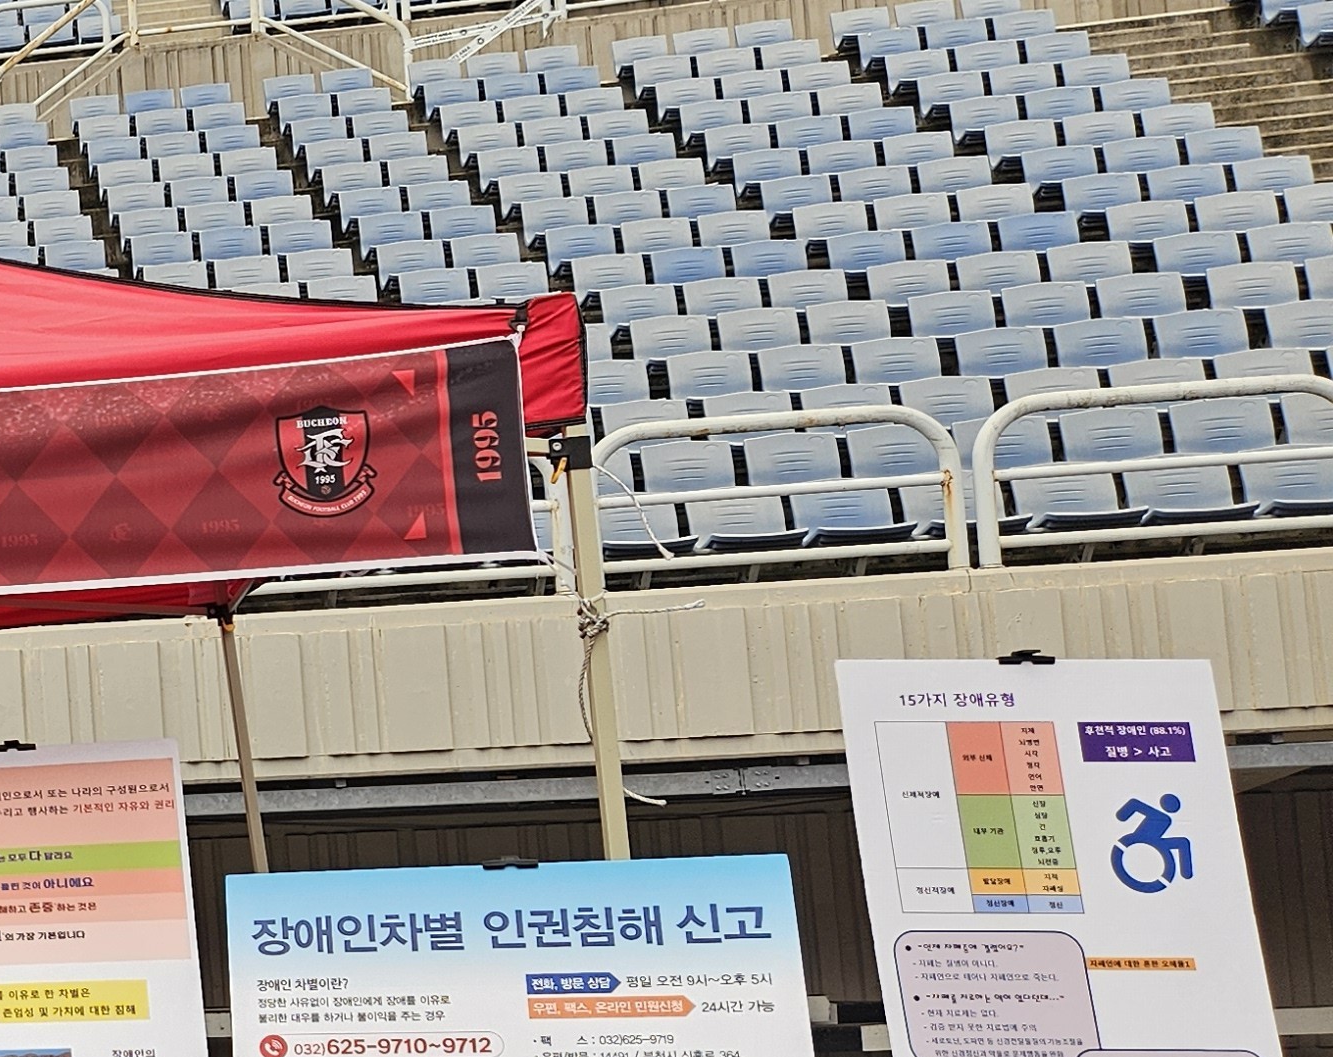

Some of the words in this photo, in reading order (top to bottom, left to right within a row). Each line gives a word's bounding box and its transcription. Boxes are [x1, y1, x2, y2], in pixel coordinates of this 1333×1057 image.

[296, 416, 348, 429] BUCHEON
[472, 410, 502, 482] 1995
[314, 474, 336, 484] 1995
[899, 693, 947, 707] 15가지
[954, 692, 1015, 707] 장애유형
[1084, 725, 1114, 736] 후천적
[1116, 725, 1147, 736] 장애인
[1149, 725, 1186, 736] (88.1%)
[1105, 746, 1129, 758] 질병
[1148, 746, 1172, 757] 사고
[47, 788, 68, 799] 또는
[71, 785, 103, 797] 나라의
[106, 782, 170, 795] 구성원으로서
[28, 804, 68, 816] 행사하는
[73, 802, 114, 814] 기본적인
[118, 800, 150, 812] 자유와
[154, 798, 175, 810] 권리
[29, 850, 41, 861] 다
[43, 876, 94, 889] 아니에요
[251, 911, 465, 956] 장애인차별
[483, 904, 664, 949] 인권침해
[676, 903, 772, 944] 신고
[256, 979, 292, 992] 장애인
[294, 977, 349, 991] 차별이란?
[531, 977, 558, 992] 전화,
[560, 977, 584, 990] 방문
[588, 976, 611, 990] 상담
[626, 975, 651, 988] 평일
[656, 974, 684, 987] 오전
[687, 973, 747, 987] 9시~오후
[751, 972, 773, 985] 5시
[9, 989, 40, 1000] 이유로
[45, 989, 54, 999] 한
[59, 987, 90, 998] 차별은
[257, 997, 287, 1009] 정당한
[290, 996, 329, 1008] 사유없이
[333, 995, 382, 1007] 장애인에게
[386, 994, 416, 1006] 장애를
[420, 994, 450, 1006] 이유로
[533, 1001, 561, 1015] 우편,
[596, 1000, 632, 1014] 온라인
[635, 1000, 684, 1013] 민원신청
[701, 1000, 744, 1013] 24시간
[748, 1000, 774, 1012] 가능
[3, 1007, 33, 1018] 존엄성
[39, 1006, 48, 1017] 및
[53, 1006, 84, 1016] 가치에
[89, 1005, 110, 1015] 대한
[115, 1004, 136, 1015] 침해
[258, 1012, 287, 1024] 불리한
[291, 1012, 320, 1023] 대우를
[324, 1011, 354, 1023] 하거나
[357, 1010, 397, 1022] 불이익을
[401, 1010, 421, 1022] 주는
[425, 1009, 446, 1021] 경우
[294, 1037, 492, 1056] 032)625-9710~9712
[599, 1034, 674, 1046] 032)625-9719
